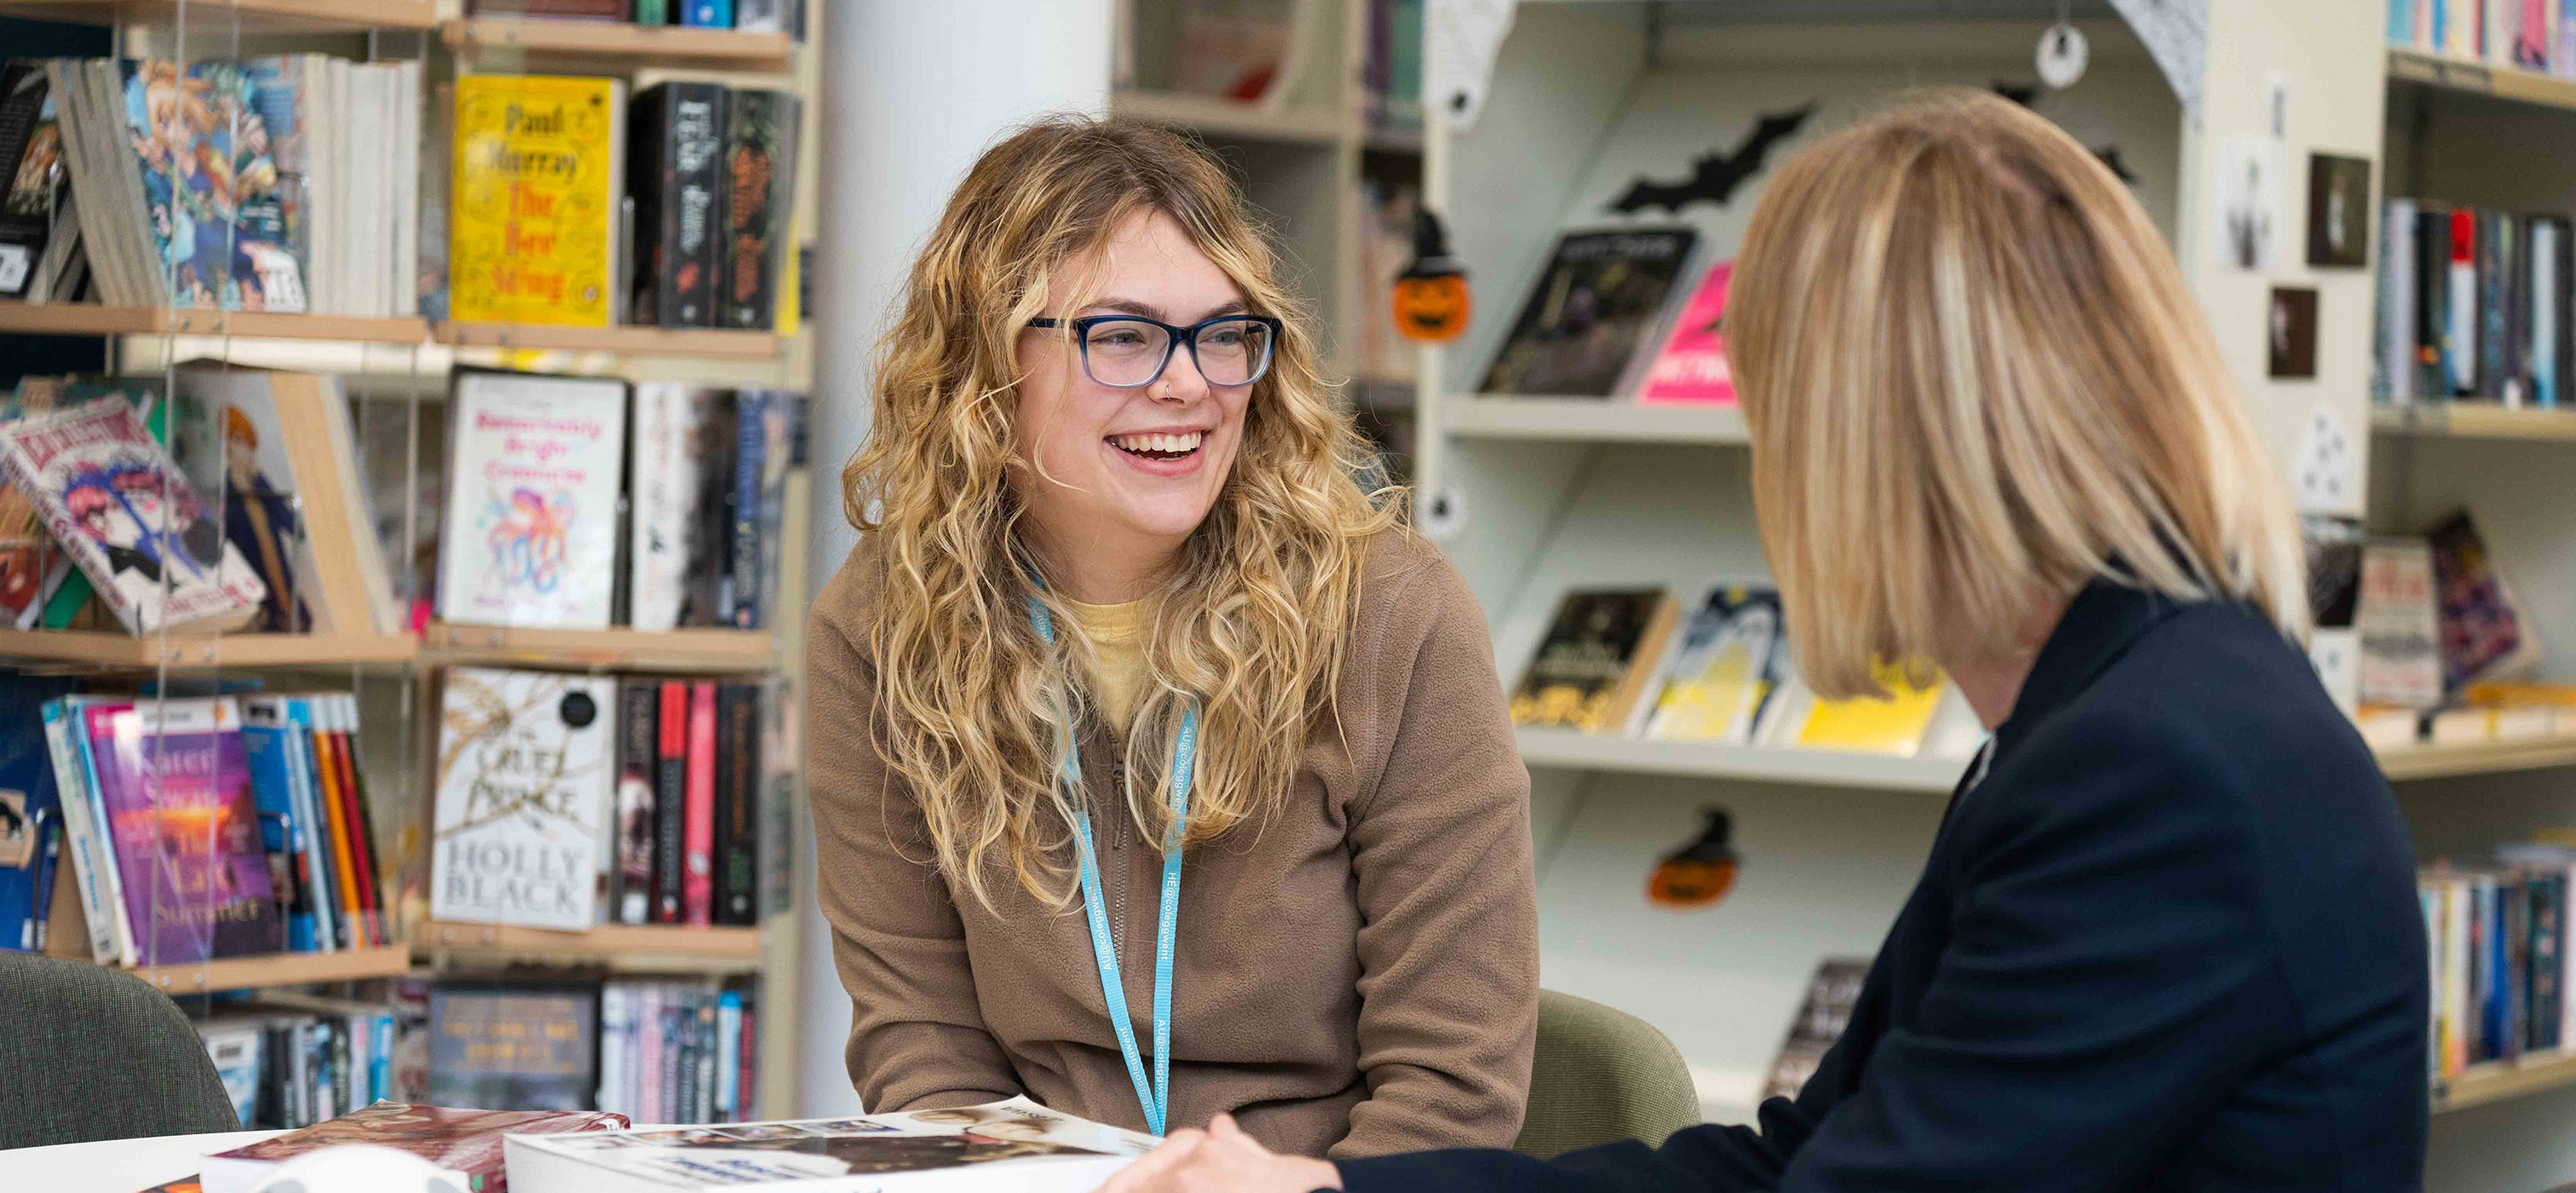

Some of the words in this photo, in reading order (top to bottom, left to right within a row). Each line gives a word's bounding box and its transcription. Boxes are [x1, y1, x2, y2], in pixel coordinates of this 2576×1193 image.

[506, 101, 565, 135] Paul
[509, 180, 555, 218] The
[447, 839, 586, 879] HOLLY
[445, 874, 581, 917] BLACK
[1159, 872, 1177, 961] HE@coleggwent
[1119, 1026, 1153, 1113] HE@coleggwent
[1155, 1017, 1170, 1109] AU@coleggwent
